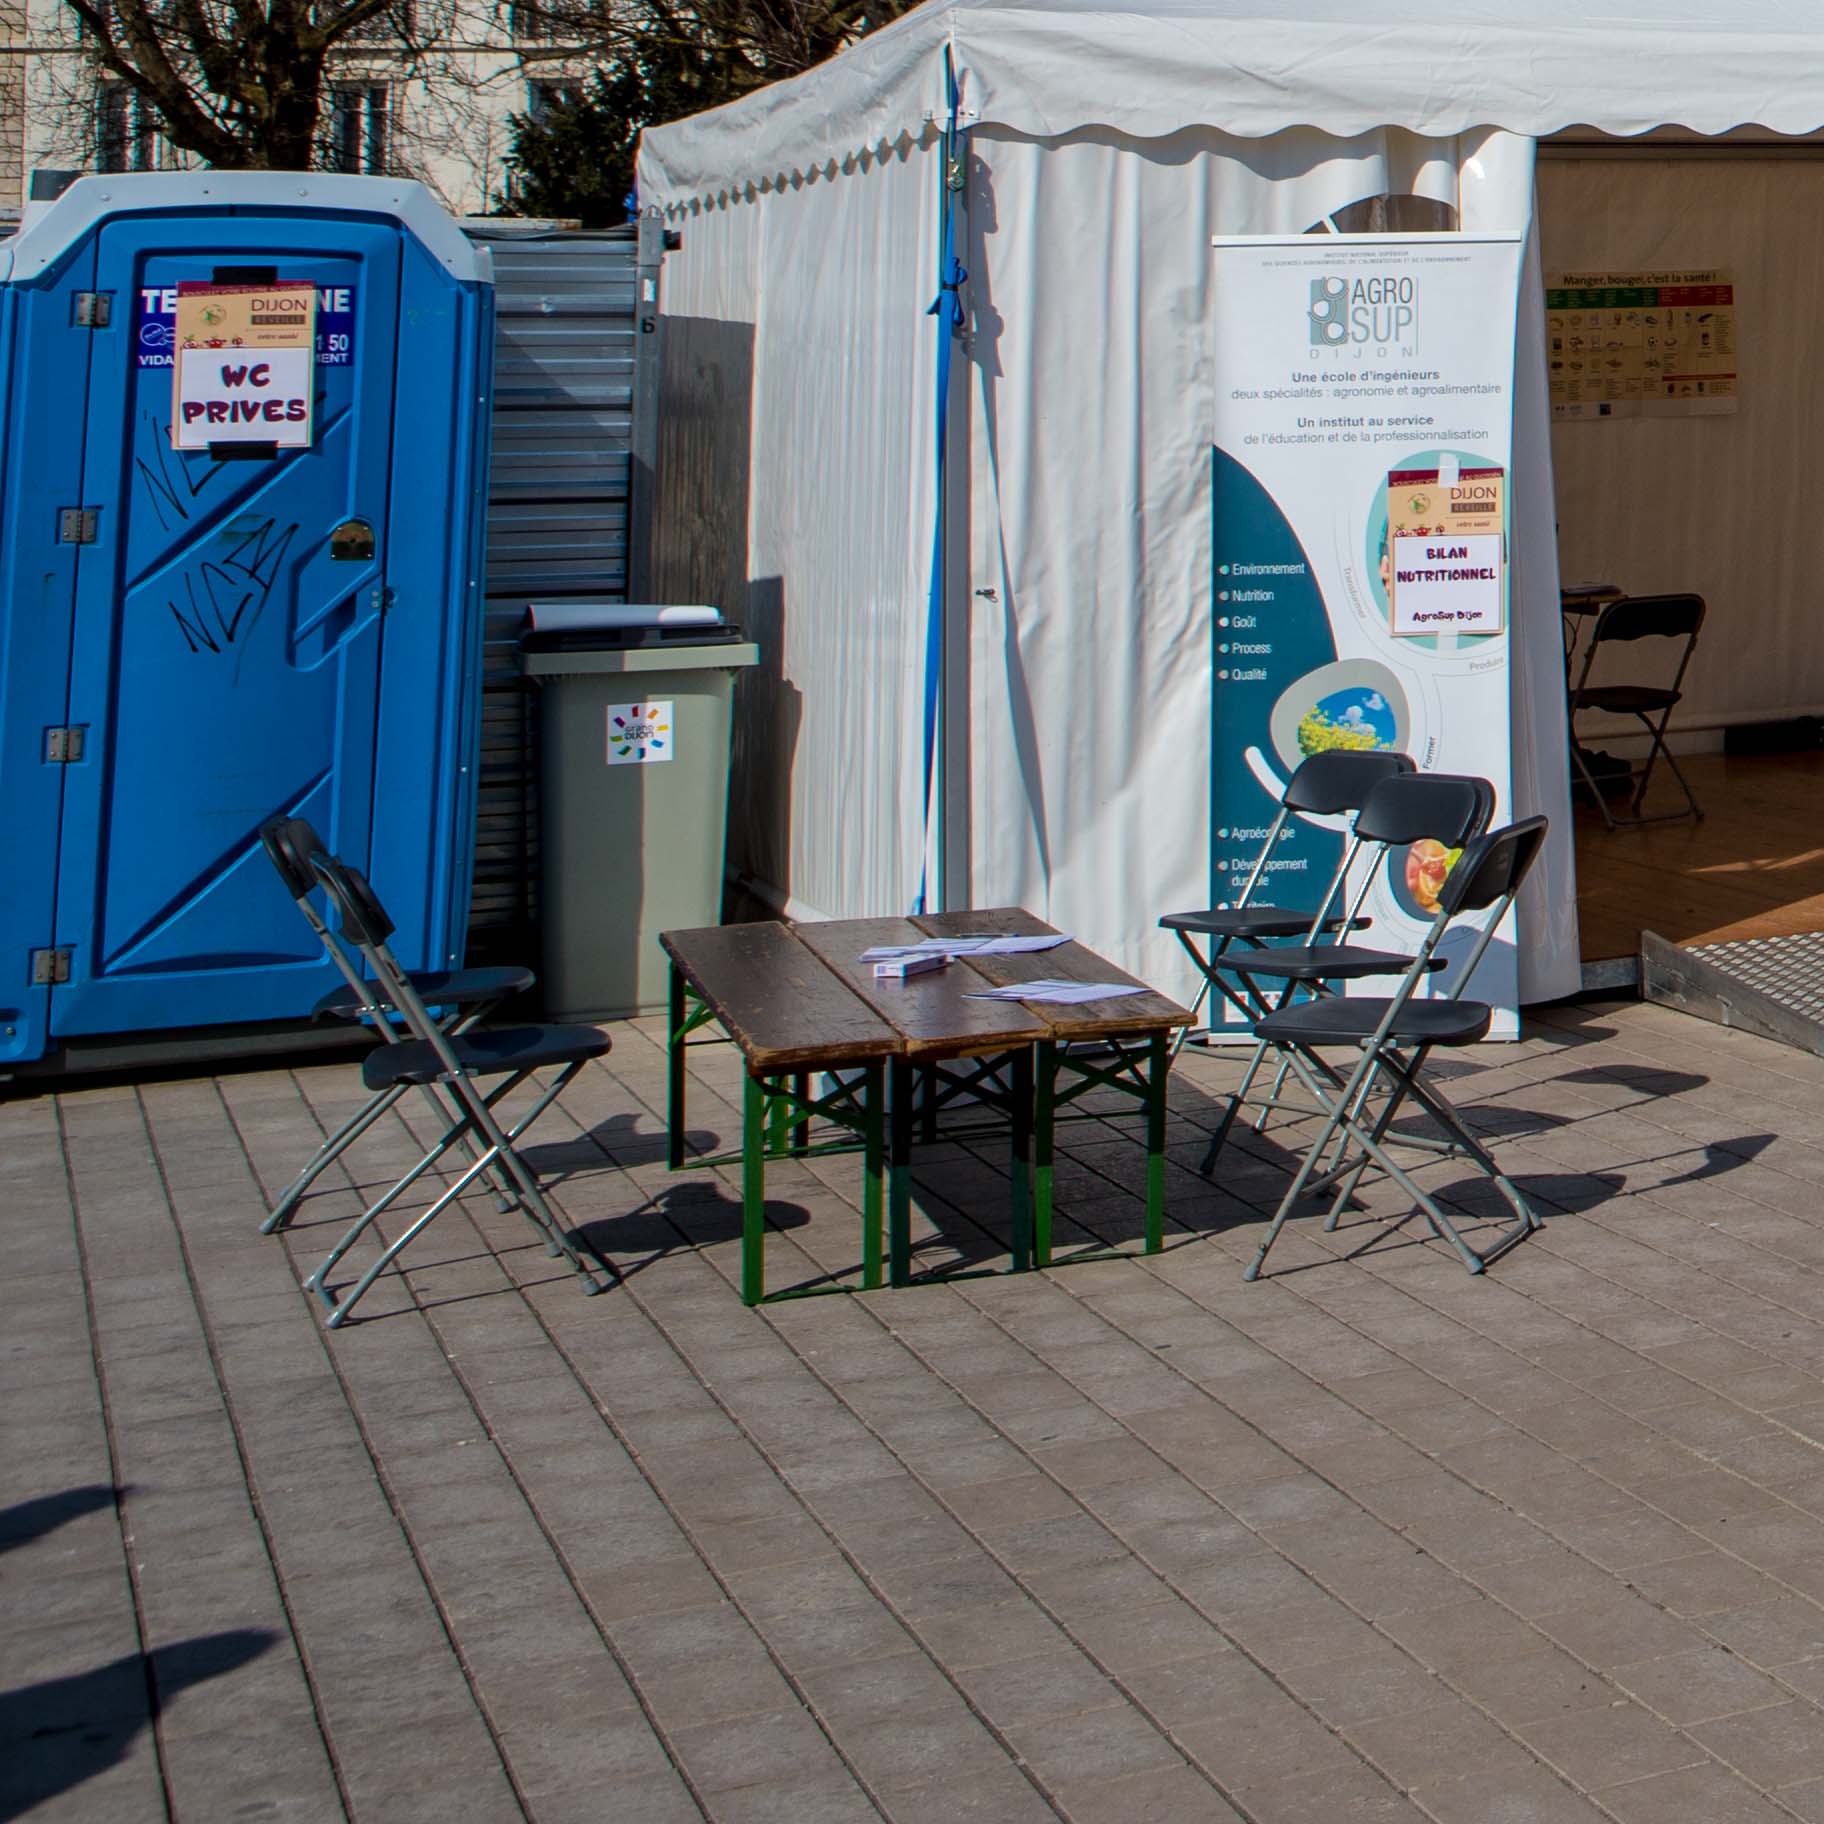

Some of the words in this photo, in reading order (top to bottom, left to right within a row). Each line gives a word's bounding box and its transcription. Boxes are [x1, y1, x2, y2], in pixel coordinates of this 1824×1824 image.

[1352, 277, 1413, 304] AGRO
[250, 298, 308, 312] DIJON
[1351, 306, 1413, 343] SUP
[328, 334, 348, 351] 50
[1310, 347, 1413, 360] DIJON
[221, 363, 270, 388] WC
[1292, 372, 1318, 383] Une
[1322, 370, 1357, 382] école
[1360, 369, 1440, 385] d'ingénieurs
[1232, 389, 1260, 400] deux
[1262, 386, 1322, 401] spécialités
[1334, 386, 1394, 400] agronomie
[1397, 386, 1408, 396] et
[1411, 384, 1502, 398] agroalimentaire
[182, 399, 306, 424] PRIVES
[1298, 417, 1314, 428] Un
[1319, 416, 1364, 428] institut
[1368, 418, 1384, 427] au
[1388, 415, 1434, 427] service
[1244, 434, 1260, 444] de
[1262, 431, 1324, 444] l'éducation
[1328, 432, 1340, 443] et
[1342, 432, 1358, 443] de
[1361, 431, 1370, 442] la
[1374, 428, 1488, 445] professionnalisation
[1451, 486, 1496, 500] DIJON
[1426, 547, 1468, 560] BILAN
[1232, 562, 1305, 576] Environnement
[1396, 568, 1496, 582] NUTRITIONNEL
[1232, 589, 1275, 602] Nutrition
[1232, 615, 1257, 628] Goût
[1412, 611, 1455, 622] AgroSup
[1232, 642, 1272, 655] Process
[1232, 668, 1268, 681] Qualité
[1423, 736, 1437, 770] Former
